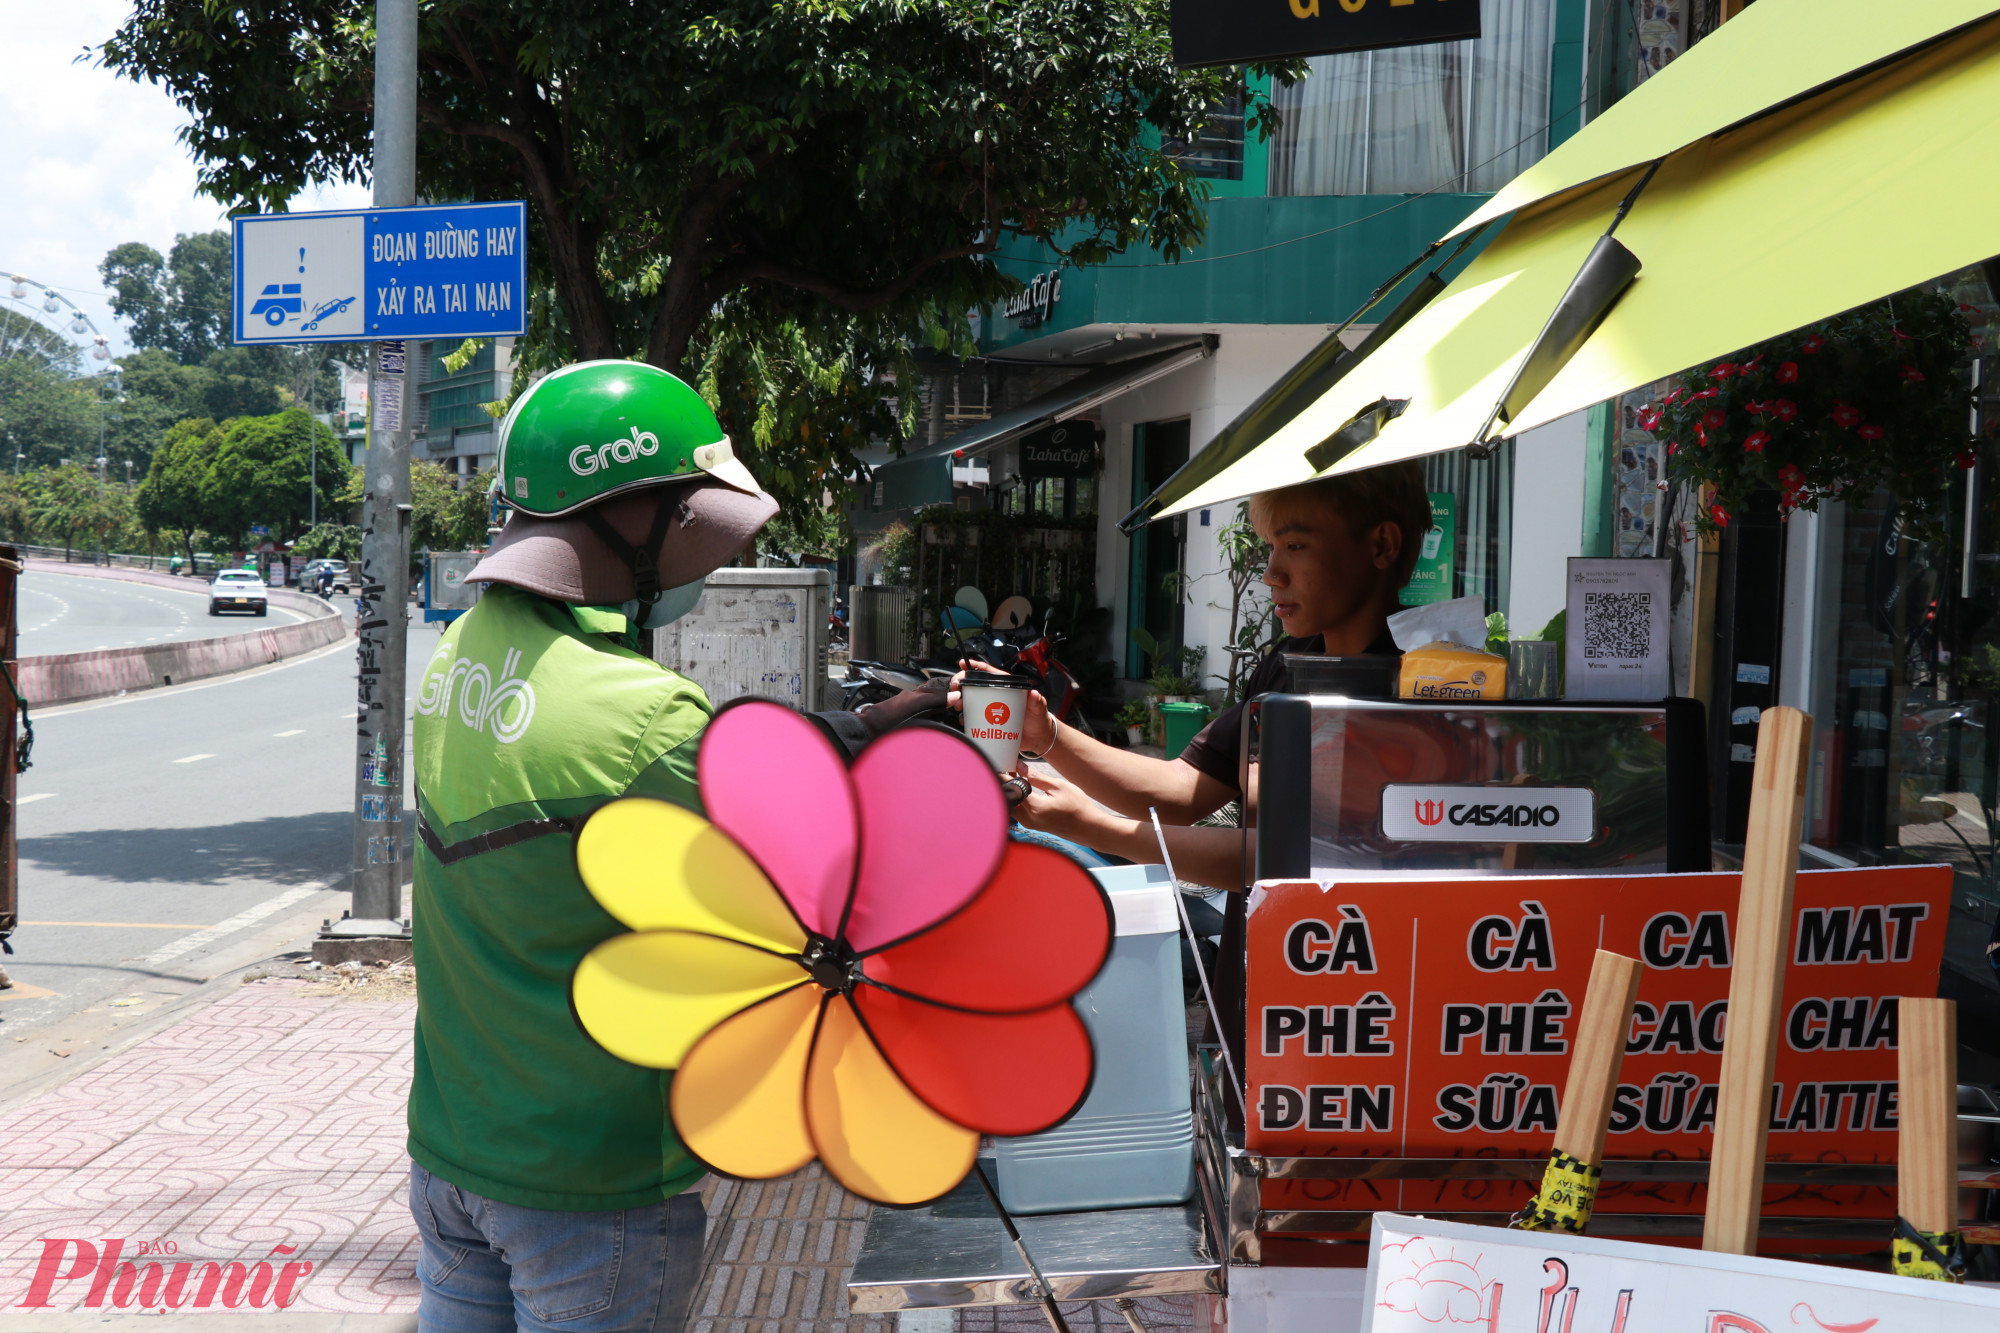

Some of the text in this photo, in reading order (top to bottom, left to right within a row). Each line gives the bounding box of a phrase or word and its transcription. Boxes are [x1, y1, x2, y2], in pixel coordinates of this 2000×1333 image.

[372, 222, 517, 266] ĐOẠN ĐƯỜNG HAY
[377, 277, 511, 317] XẢY RA TAI NẠN
[569, 426, 659, 476] Grab
[1027, 446, 1091, 469] Laha Café
[1438, 563, 1448, 584] 1
[417, 643, 535, 743] Grab
[1413, 681, 1481, 698] Let-green
[971, 728, 1019, 740] WellBrew
[1449, 805, 1560, 826] CASADIO
[1284, 904, 1377, 975] CÀ
[1467, 901, 1556, 972] CÀ
[1640, 911, 1732, 970] CA
[1793, 903, 1929, 966] MAT
[1262, 992, 1395, 1056] PHÊ
[1440, 989, 1571, 1055] PHÊ
[1625, 1000, 1728, 1055] CAO
[1786, 996, 1900, 1051] CHA
[1257, 1085, 1395, 1132] ĐEN
[1433, 1073, 1560, 1133] SỮA
[1607, 1072, 1719, 1134] SỮA
[1768, 1080, 1900, 1132] LATTE
